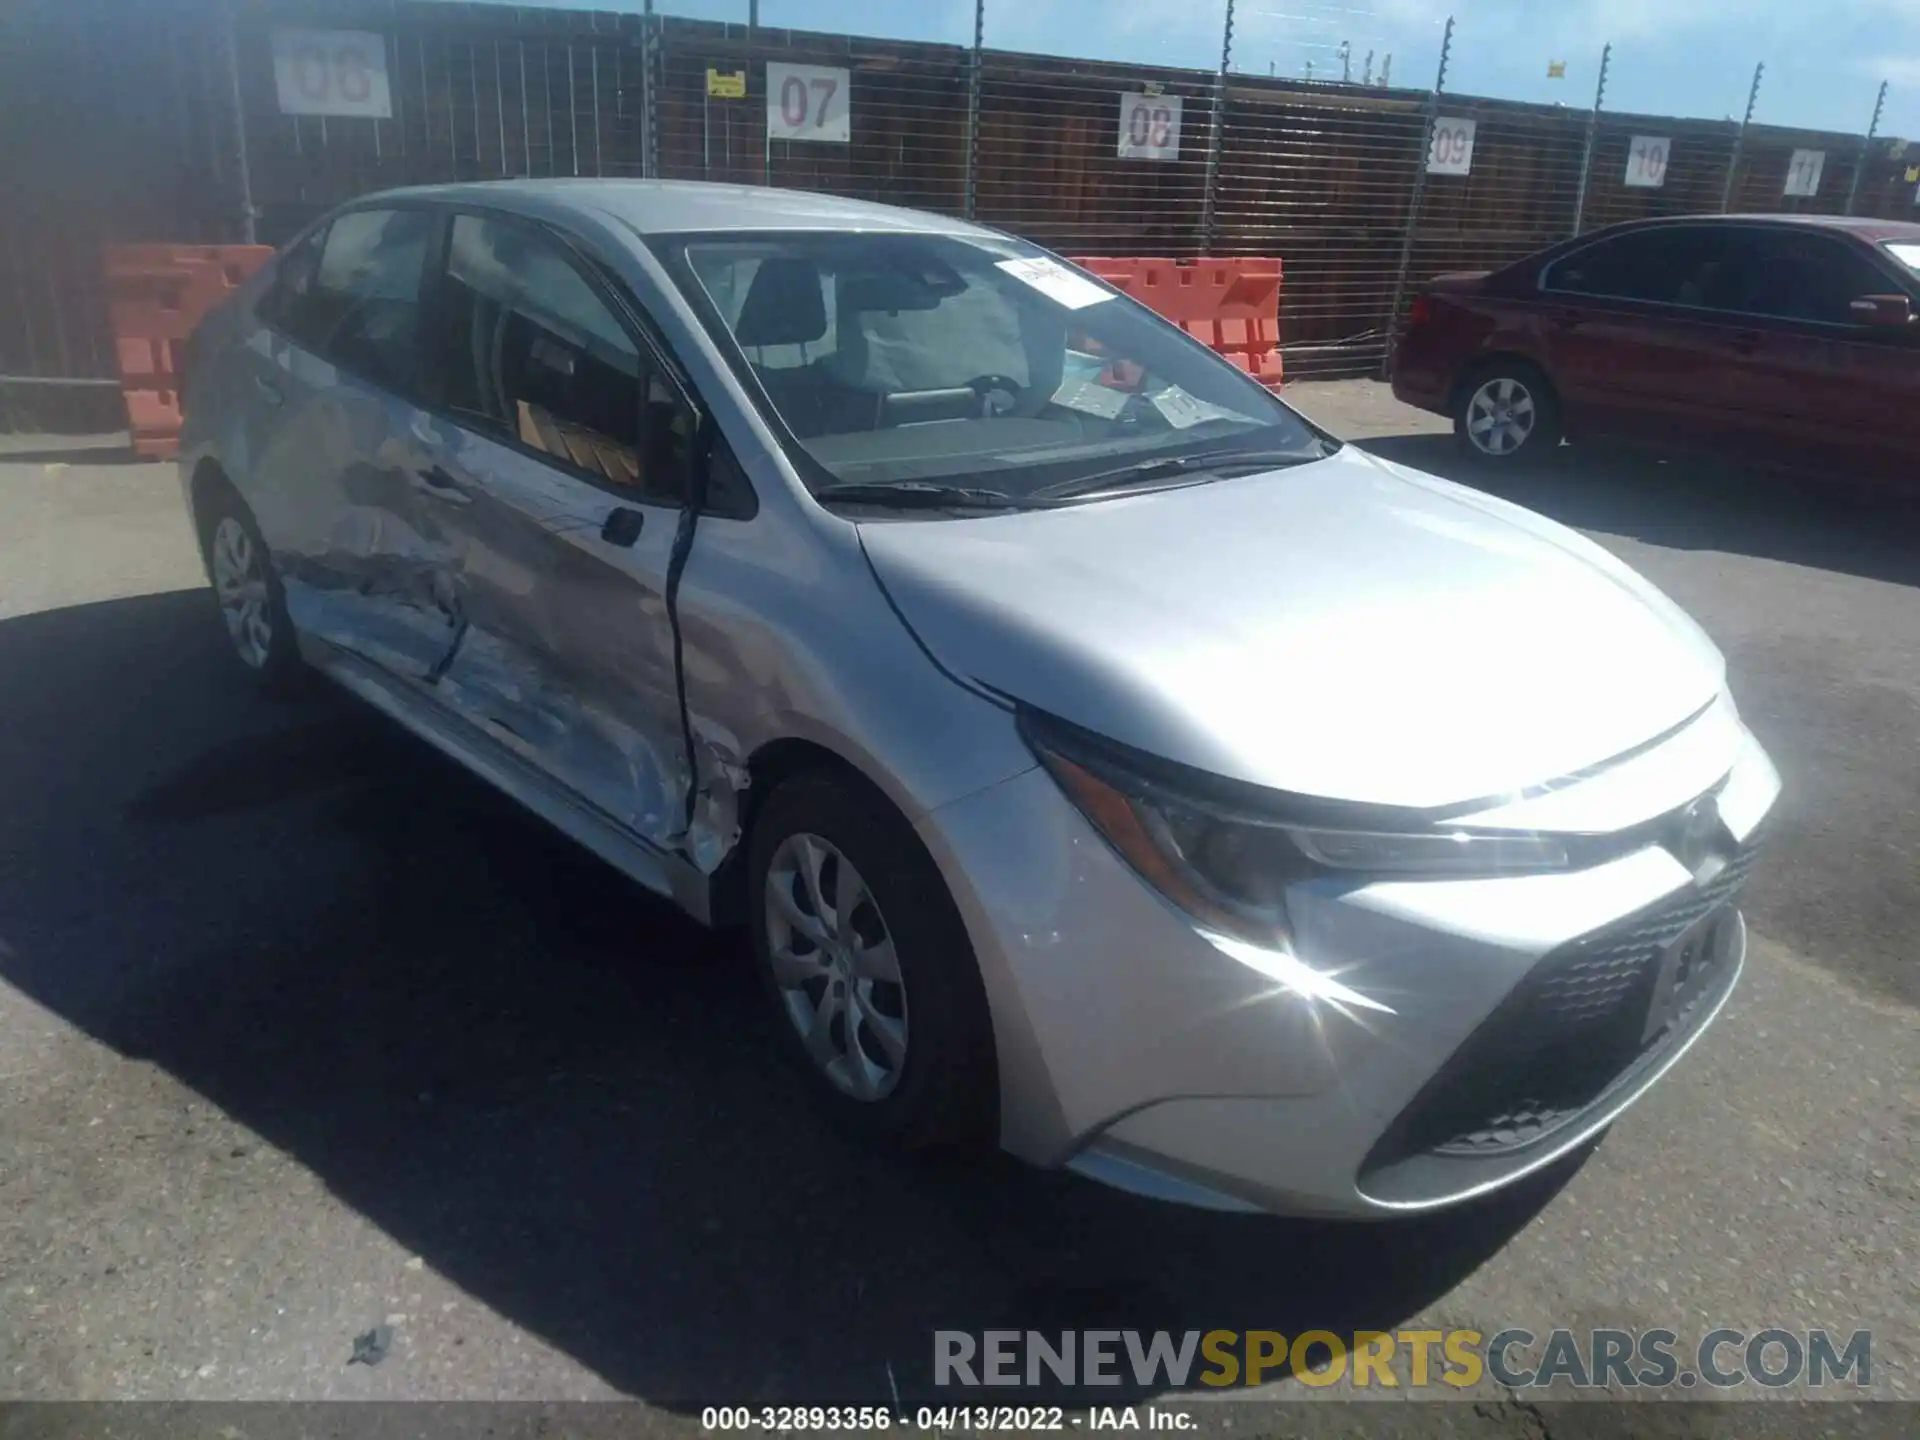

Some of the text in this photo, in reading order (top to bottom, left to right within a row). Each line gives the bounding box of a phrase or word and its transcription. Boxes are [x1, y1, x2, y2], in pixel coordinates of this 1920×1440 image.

[781, 76, 837, 128] 07
[1129, 103, 1172, 148] 08
[1436, 126, 1468, 165] 09
[1636, 142, 1663, 179] 10
